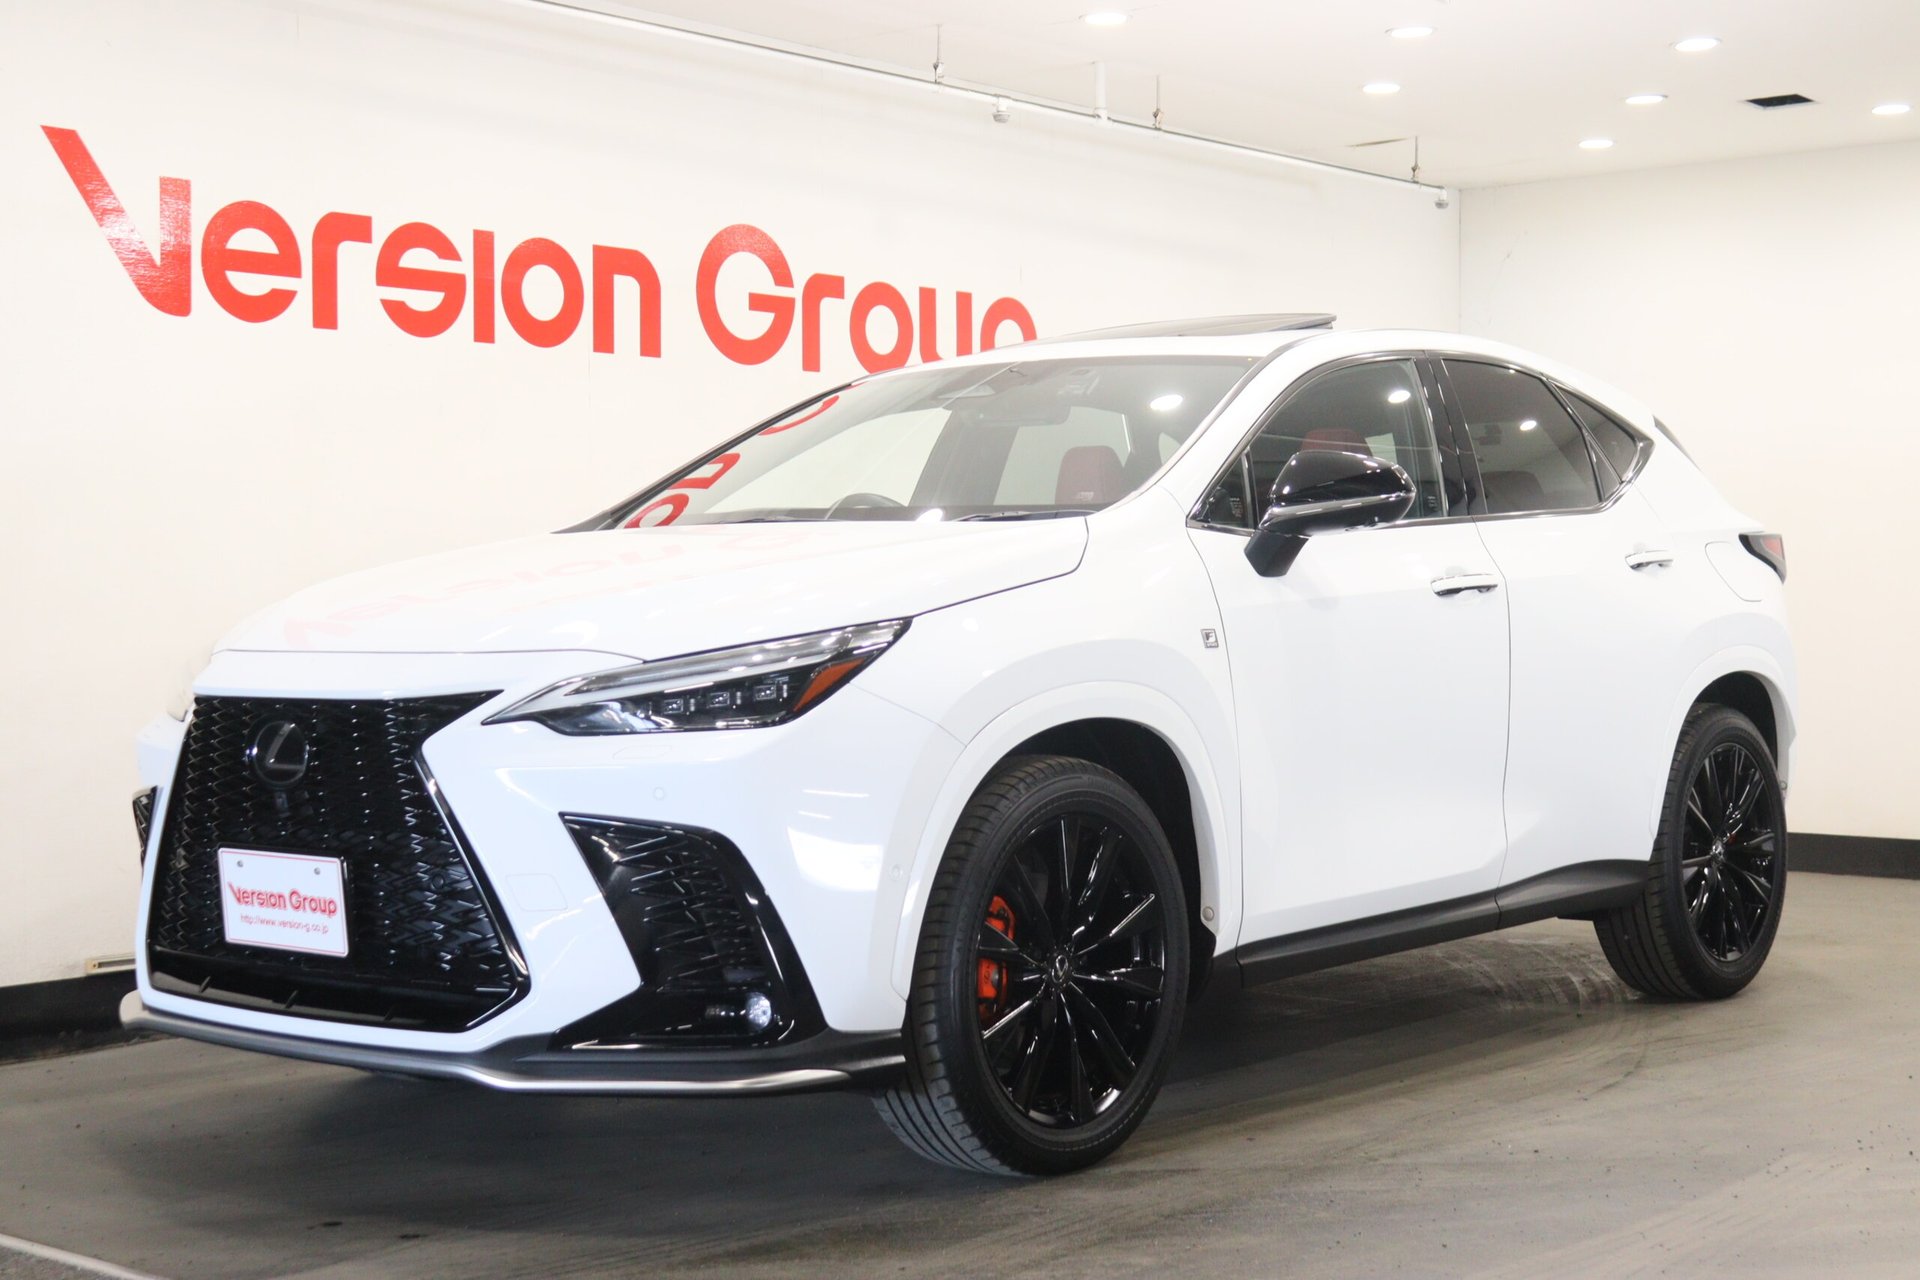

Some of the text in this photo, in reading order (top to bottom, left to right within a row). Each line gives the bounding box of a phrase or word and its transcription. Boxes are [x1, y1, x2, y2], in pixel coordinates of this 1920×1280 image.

[40, 124, 662, 359] Version
[228, 882, 338, 918] Version Group
